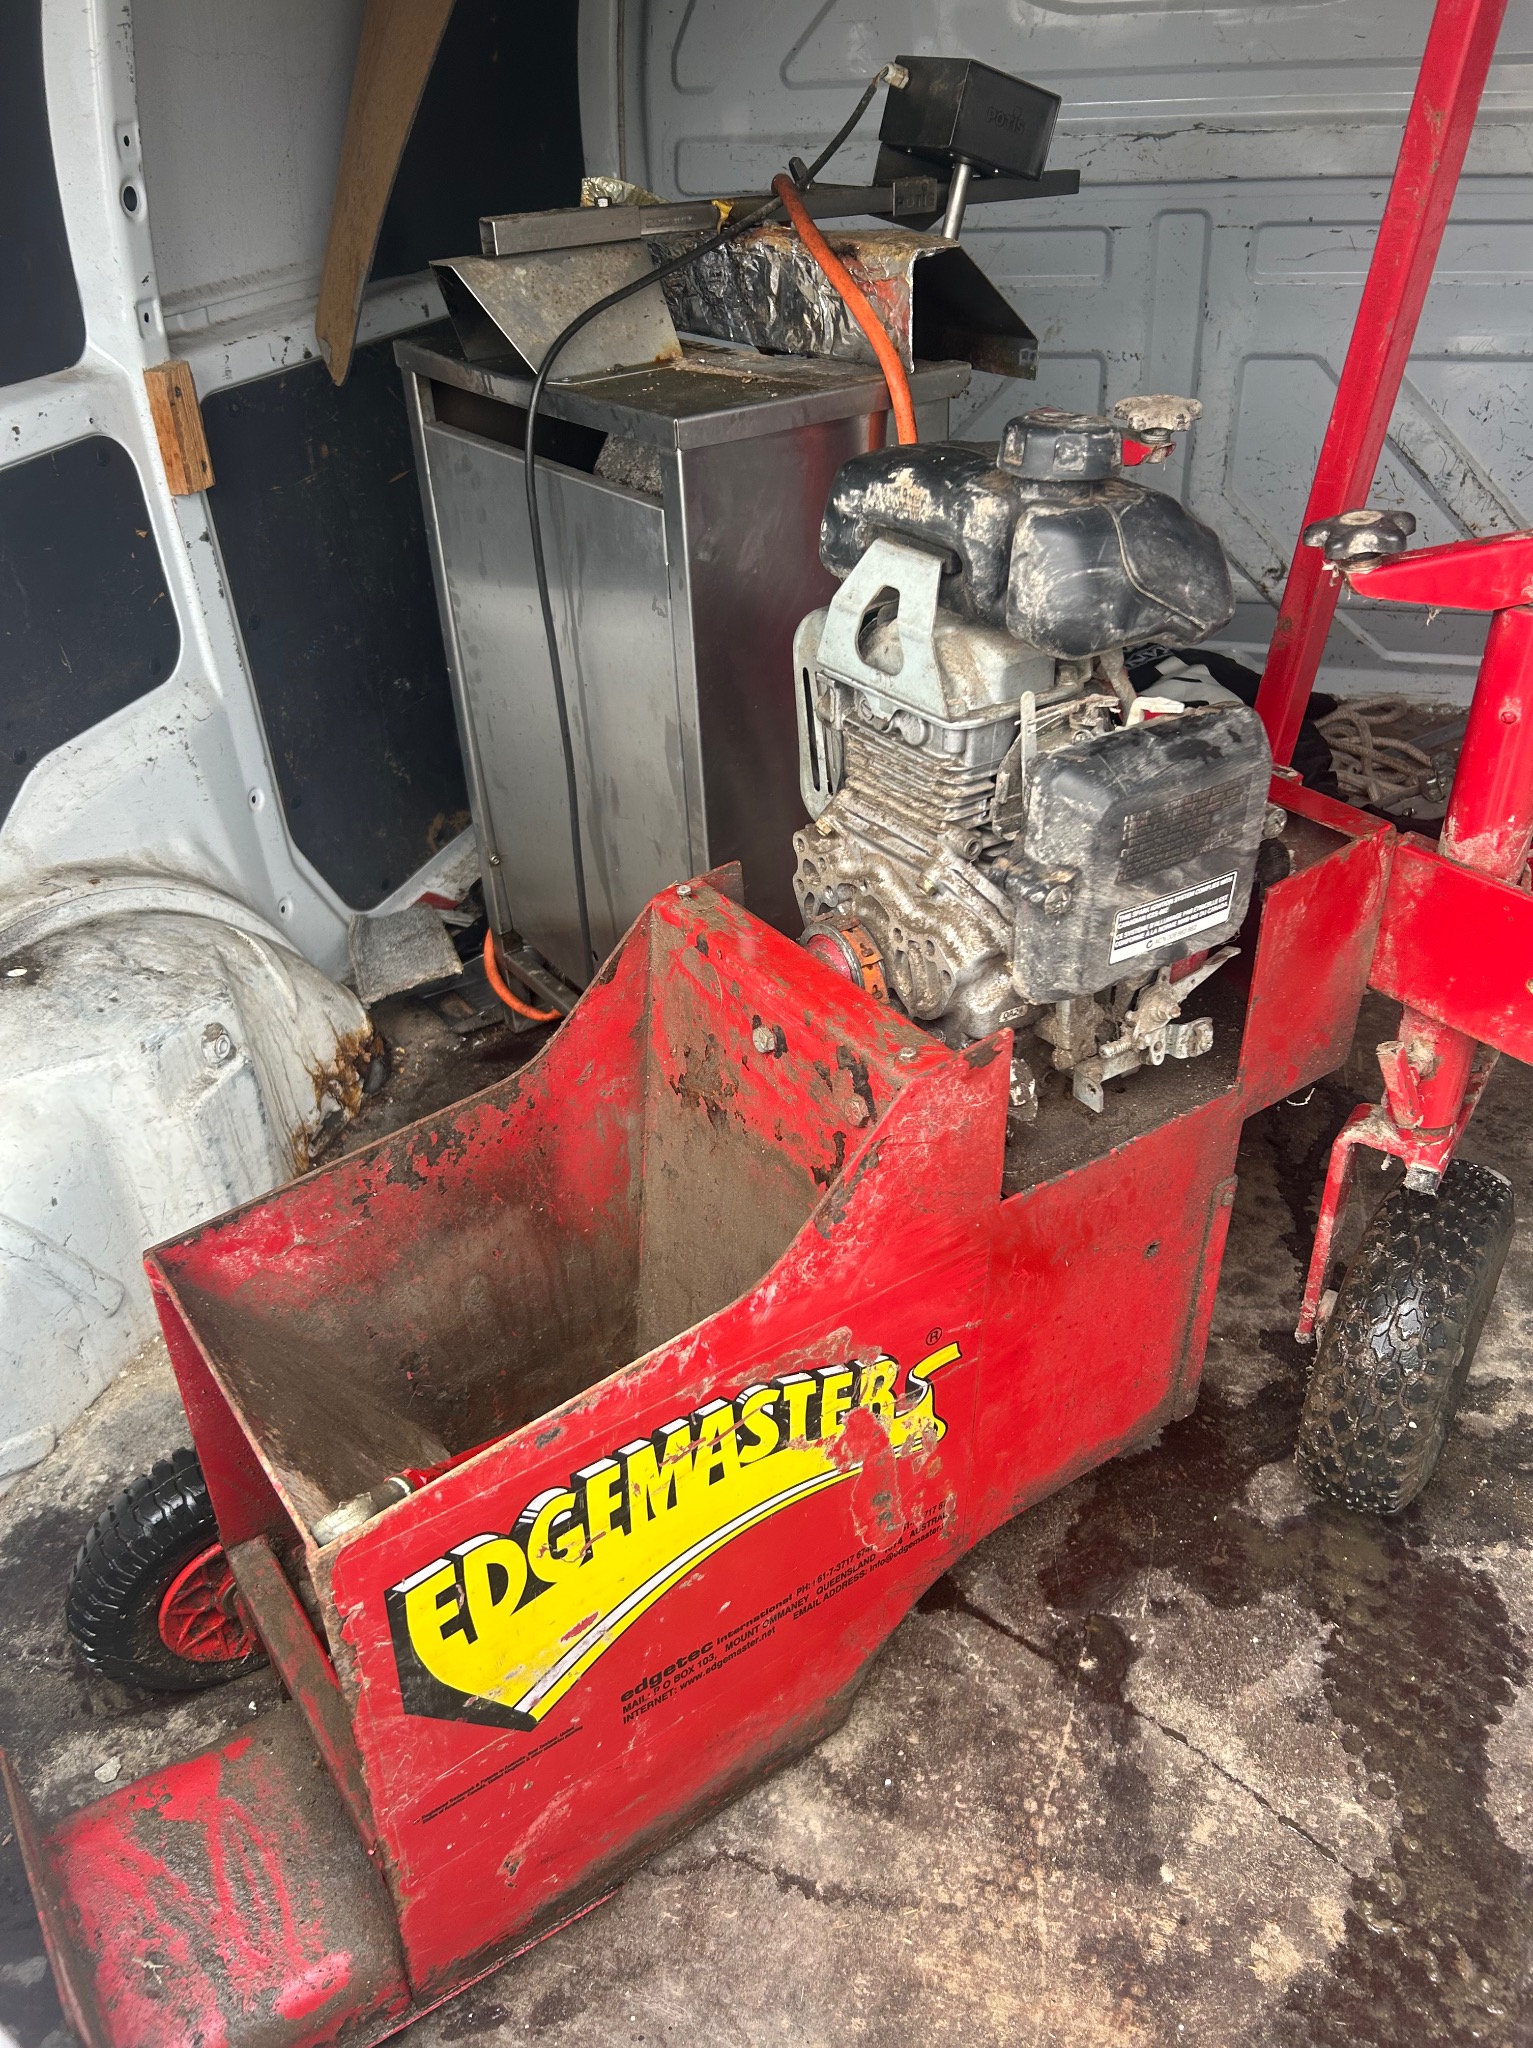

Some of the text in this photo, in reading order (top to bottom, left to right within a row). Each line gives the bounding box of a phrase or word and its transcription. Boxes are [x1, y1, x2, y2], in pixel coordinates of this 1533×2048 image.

[1132, 907, 1150, 918] SPARK
[1150, 899, 1174, 911] IGNITION
[1174, 891, 1195, 903] SYSTEM
[1195, 882, 1219, 896] COMPLIES
[623, 1688, 678, 1725] INTERNET:
[679, 1626, 777, 1691] www.edgemaster.net
[792, 1598, 822, 1621] EMAIL
[822, 1569, 868, 1603] ADDRESS:
[663, 1680, 671, 1690] O
[674, 1667, 695, 1684] BOX
[725, 1626, 761, 1653] MOUNT
[816, 1553, 876, 1596] QUEENSLAND
[620, 1641, 714, 1703] edgetec
